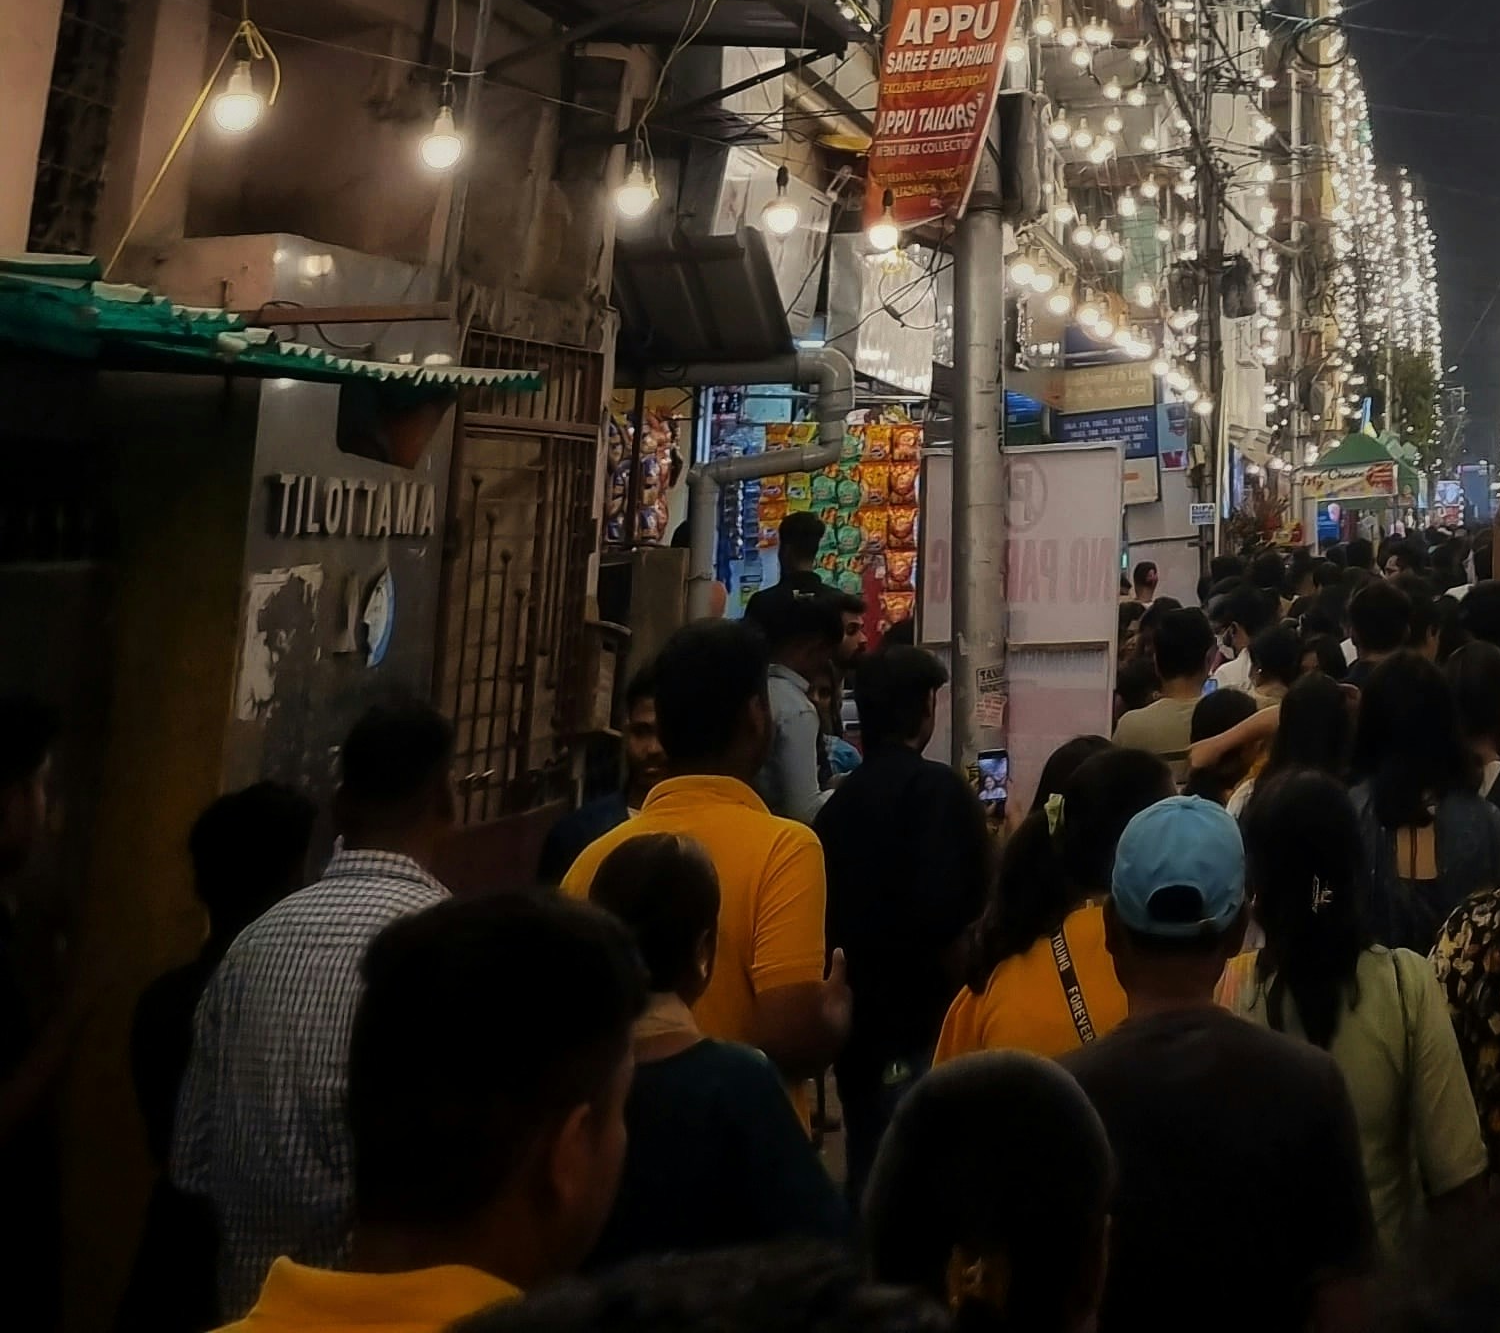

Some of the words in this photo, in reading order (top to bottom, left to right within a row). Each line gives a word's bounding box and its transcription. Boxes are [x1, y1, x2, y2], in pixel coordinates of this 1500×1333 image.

[898, 1, 1000, 46] APPU
[886, 50, 930, 74] SAREE
[930, 42, 997, 71] EMPORIUM
[877, 109, 916, 135] APPU
[918, 102, 977, 132] TAILORS
[279, 470, 436, 535] TILOTTAMA
[1052, 932, 1071, 972] YOUNG
[1067, 985, 1094, 1044] FOREVER
